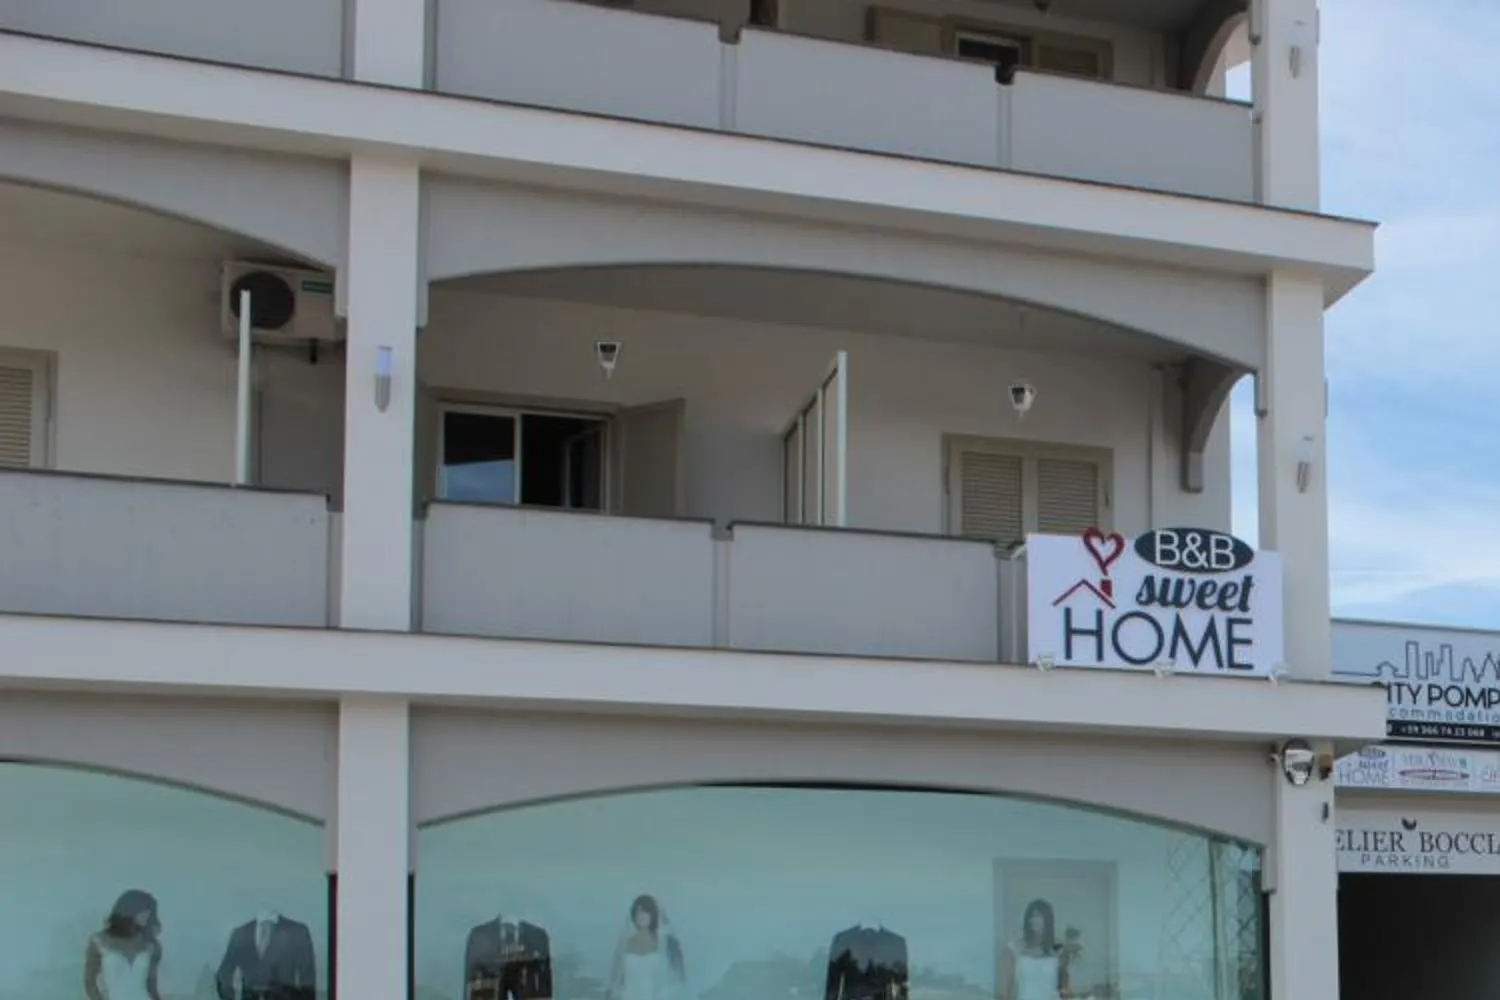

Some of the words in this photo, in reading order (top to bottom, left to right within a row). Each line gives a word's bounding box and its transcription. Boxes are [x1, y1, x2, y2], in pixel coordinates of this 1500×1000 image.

[1154, 529, 1236, 570] B&B
[1135, 574, 1255, 613] sweet
[1063, 606, 1254, 670] HOME
[1374, 681, 1422, 706] ITY
[1334, 829, 1405, 853] ELIER
[1361, 853, 1450, 869] PARKING
